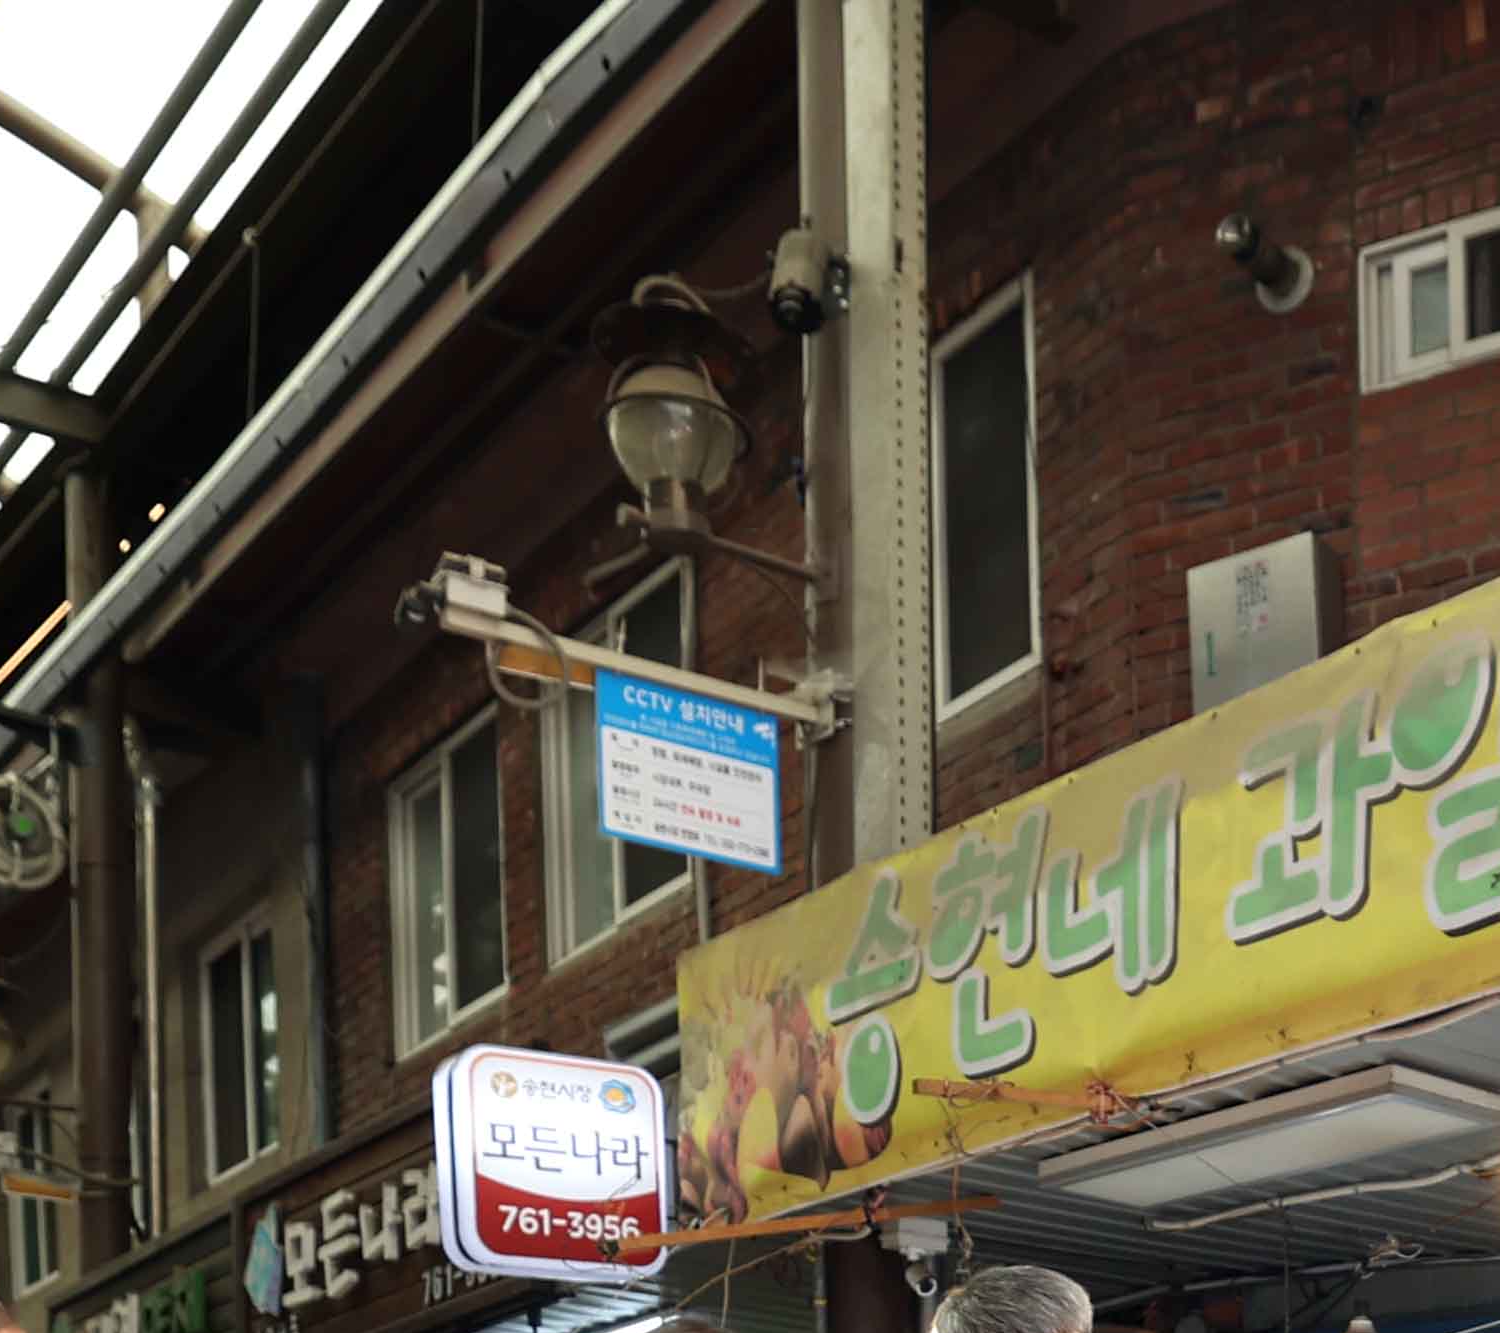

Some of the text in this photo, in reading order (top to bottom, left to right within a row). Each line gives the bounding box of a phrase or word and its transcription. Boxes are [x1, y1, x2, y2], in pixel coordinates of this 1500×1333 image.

[623, 685, 674, 713] CCTV
[825, 773, 1184, 1129] 송현네
[521, 1078, 592, 1103] 송현시장
[483, 1122, 649, 1180] 모든나라
[498, 1203, 640, 1242] 761-3956
